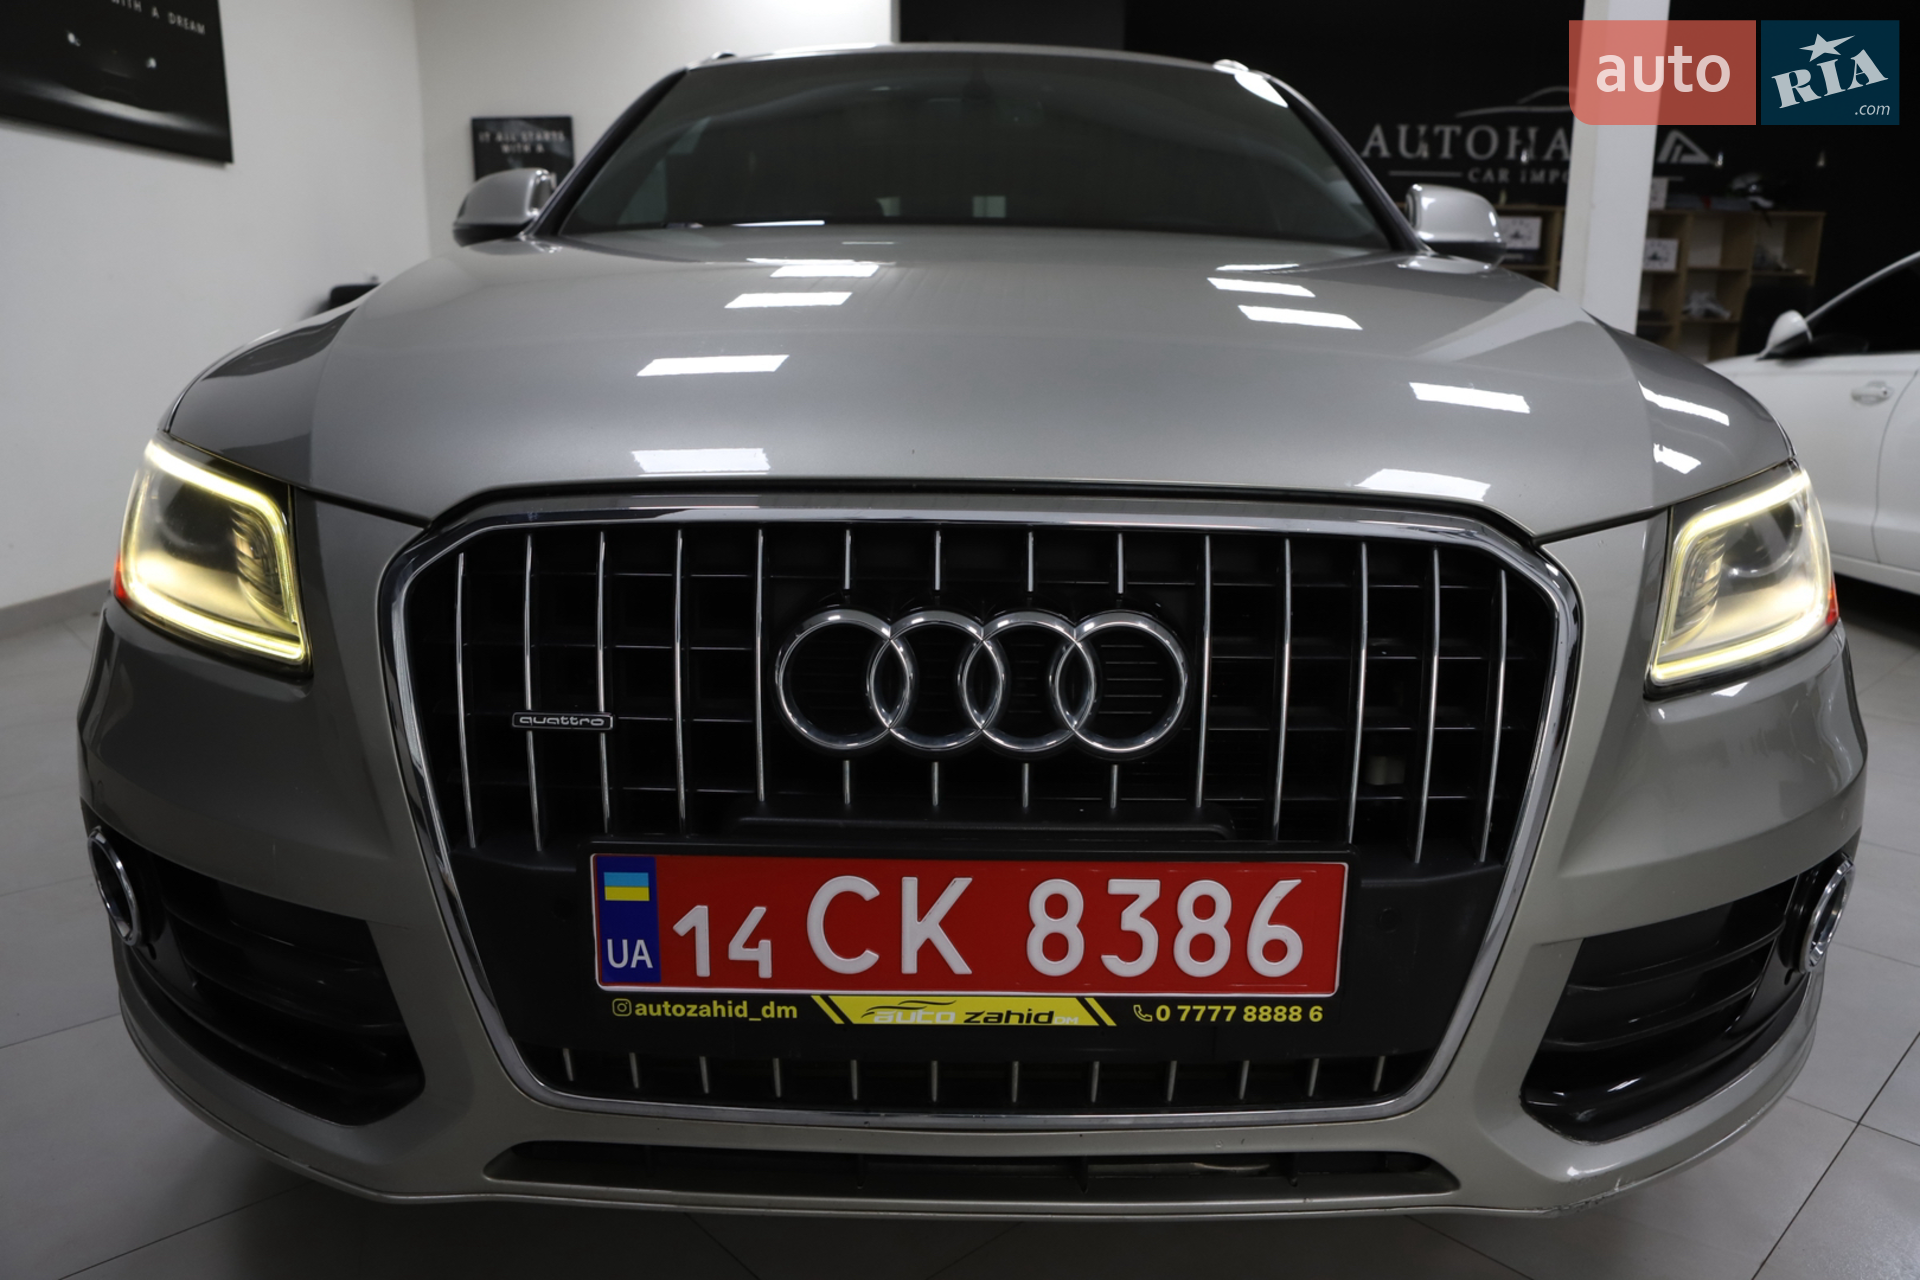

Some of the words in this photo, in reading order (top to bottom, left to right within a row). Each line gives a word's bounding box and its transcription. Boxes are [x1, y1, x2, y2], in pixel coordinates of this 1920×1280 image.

[152, 6, 160, 19] A
[168, 12, 206, 35] DREAM
[1468, 167, 1511, 183] CAR
[519, 715, 605, 726] quattro
[672, 905, 773, 979] 14
[806, 875, 973, 975] CK
[1026, 878, 1304, 978] 8386
[606, 938, 654, 969] UA
[634, 1000, 798, 1022] autozahid_dm
[872, 1008, 956, 1025] auto
[1155, 1004, 1171, 1022] 0
[1177, 1004, 1236, 1022] 7777
[1243, 1004, 1302, 1023] 8888
[1309, 1004, 1323, 1023] 6
